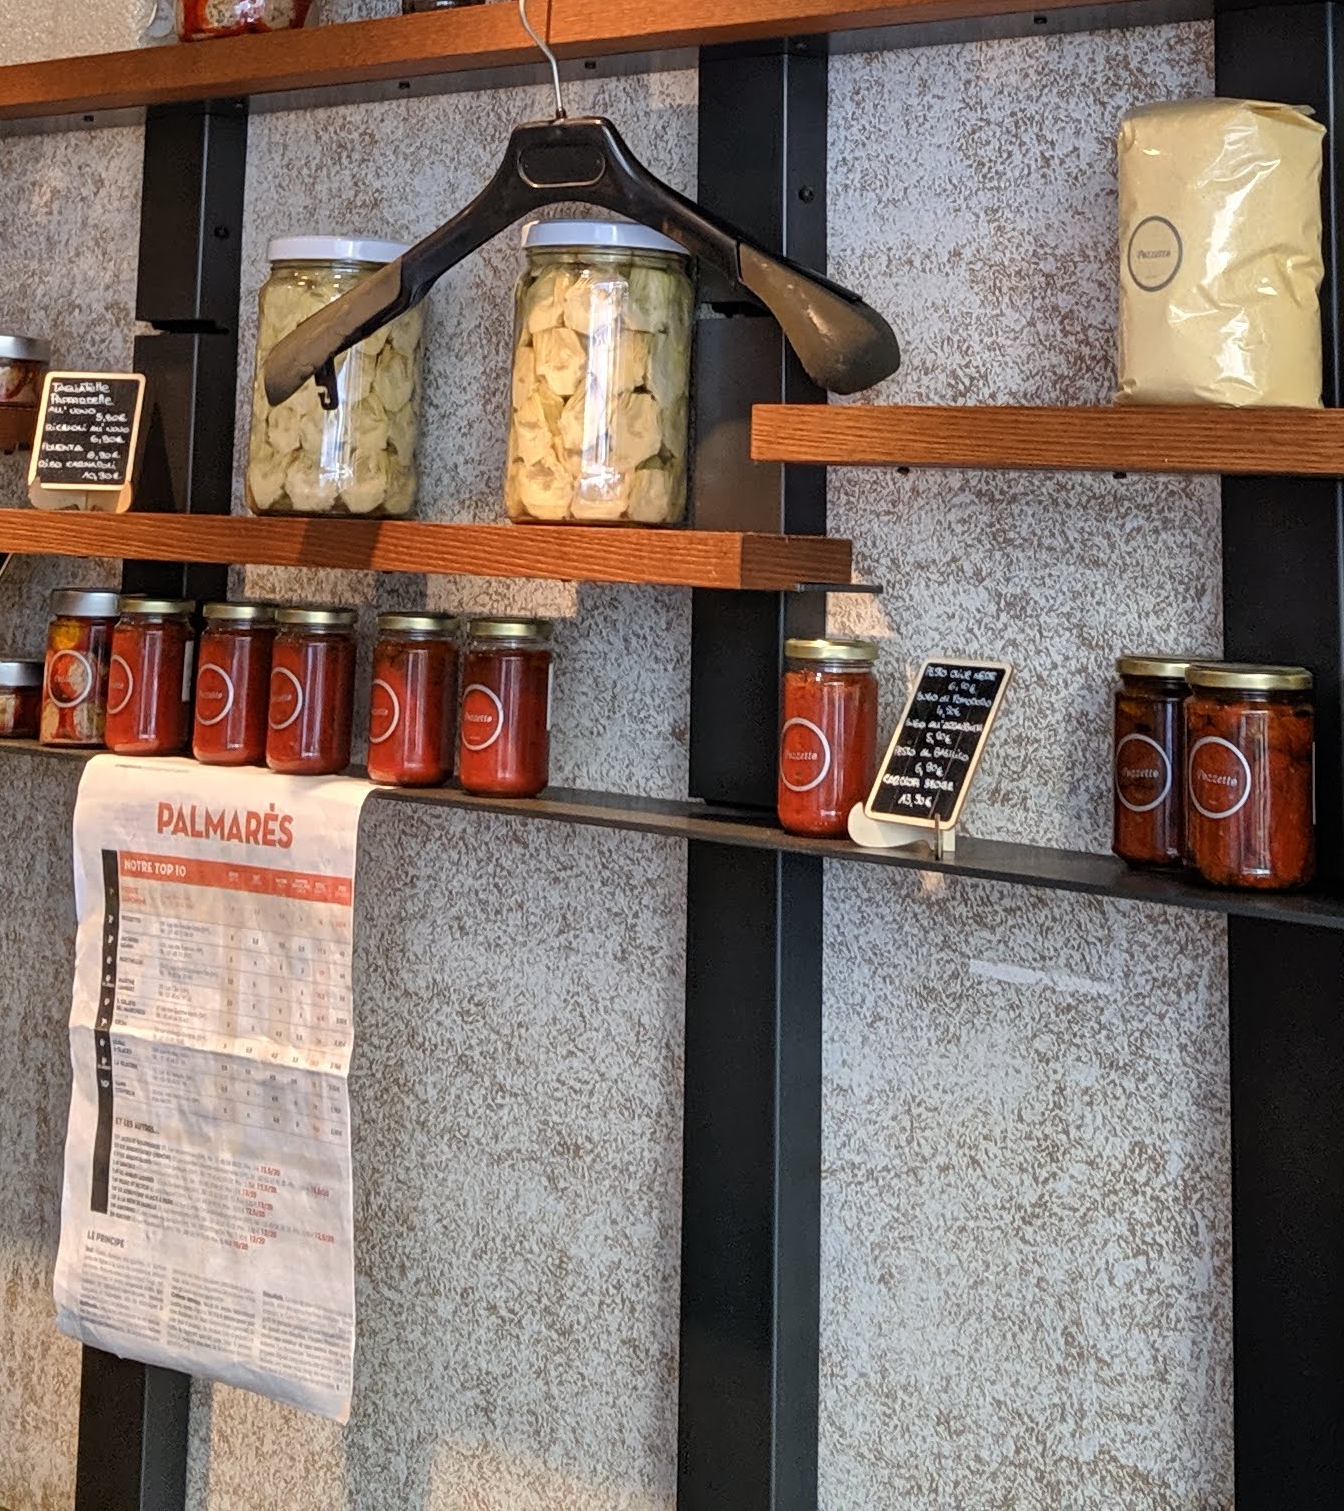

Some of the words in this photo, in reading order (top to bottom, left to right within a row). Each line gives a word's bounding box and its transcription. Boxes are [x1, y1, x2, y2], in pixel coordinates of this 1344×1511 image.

[157, 801, 294, 849] PALMARÈS
[124, 859, 152, 874] NOTRE
[154, 862, 173, 876] TOP
[175, 865, 187, 878] 10
